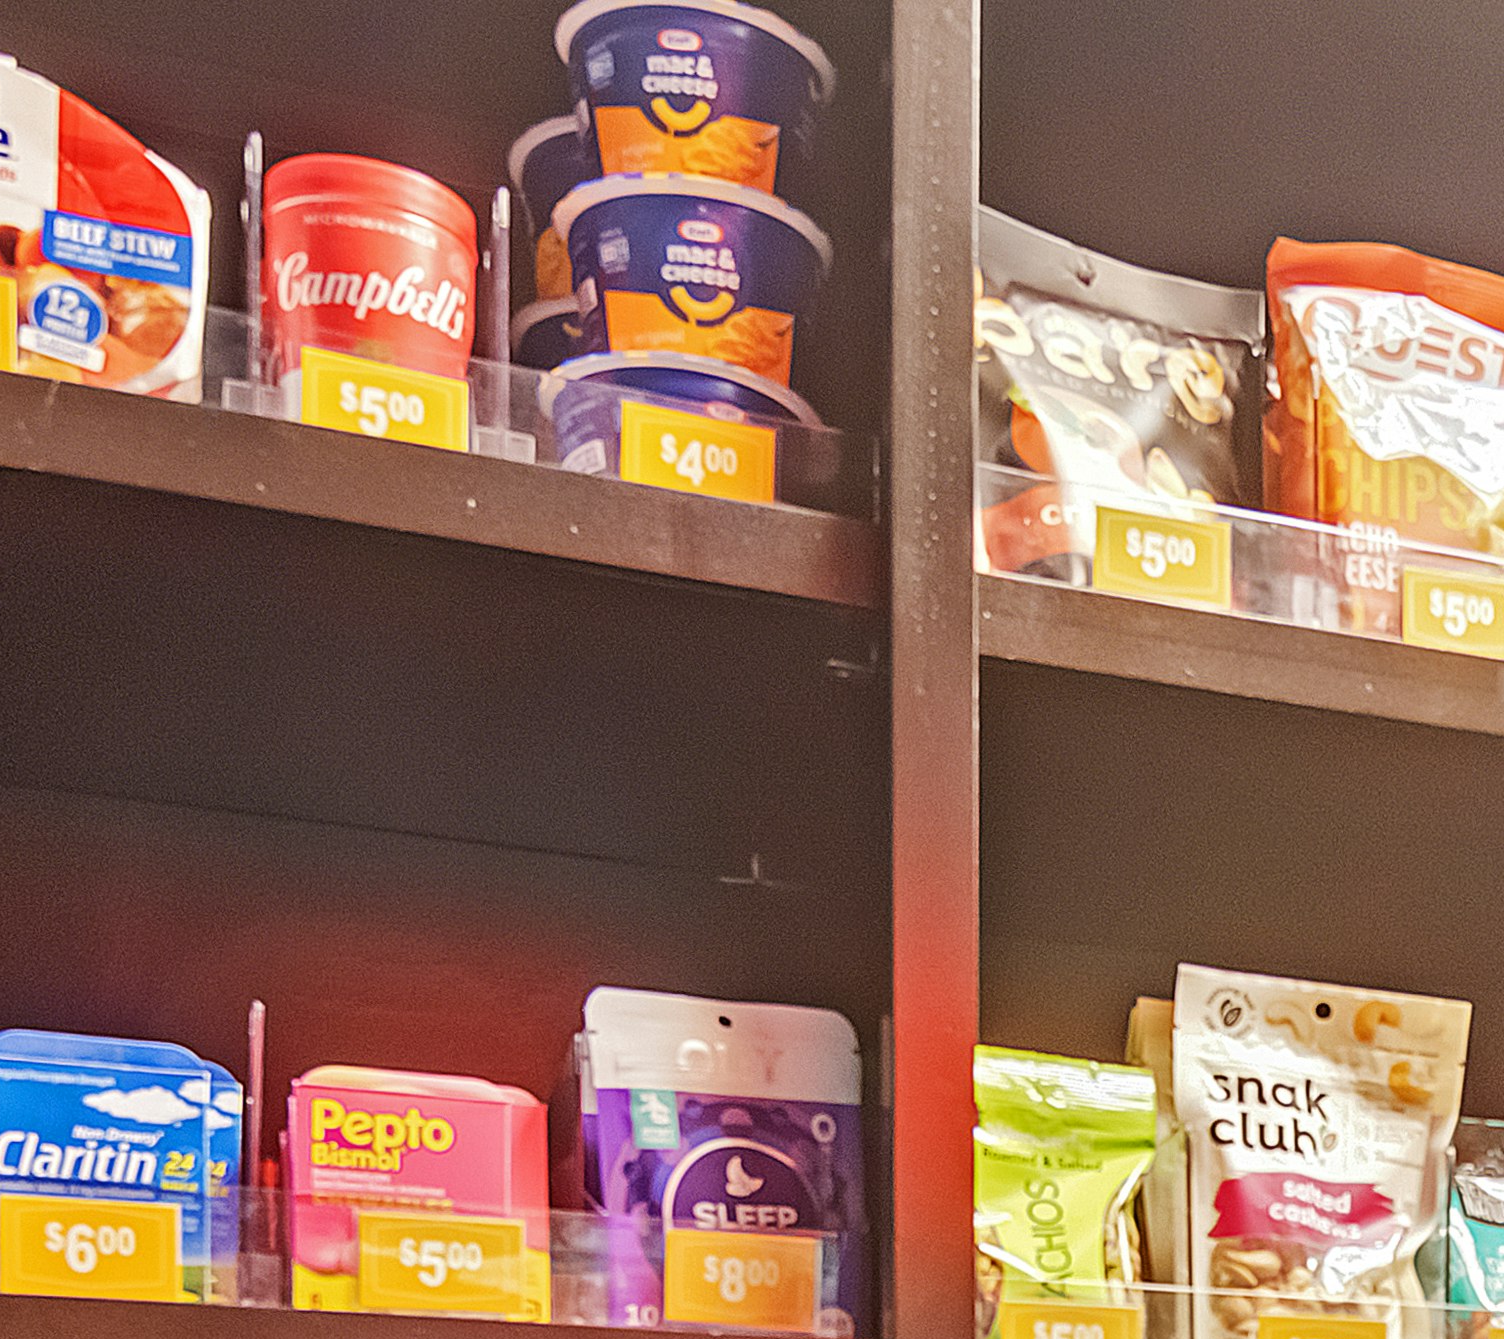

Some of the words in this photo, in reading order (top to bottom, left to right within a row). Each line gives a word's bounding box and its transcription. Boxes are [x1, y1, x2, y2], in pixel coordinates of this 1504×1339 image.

[1208, 1074, 1329, 1123] snak
[309, 1097, 456, 1154] Pepto
[309, 1143, 403, 1173] Bismol
[692, 1201, 799, 1230] SLEEP
